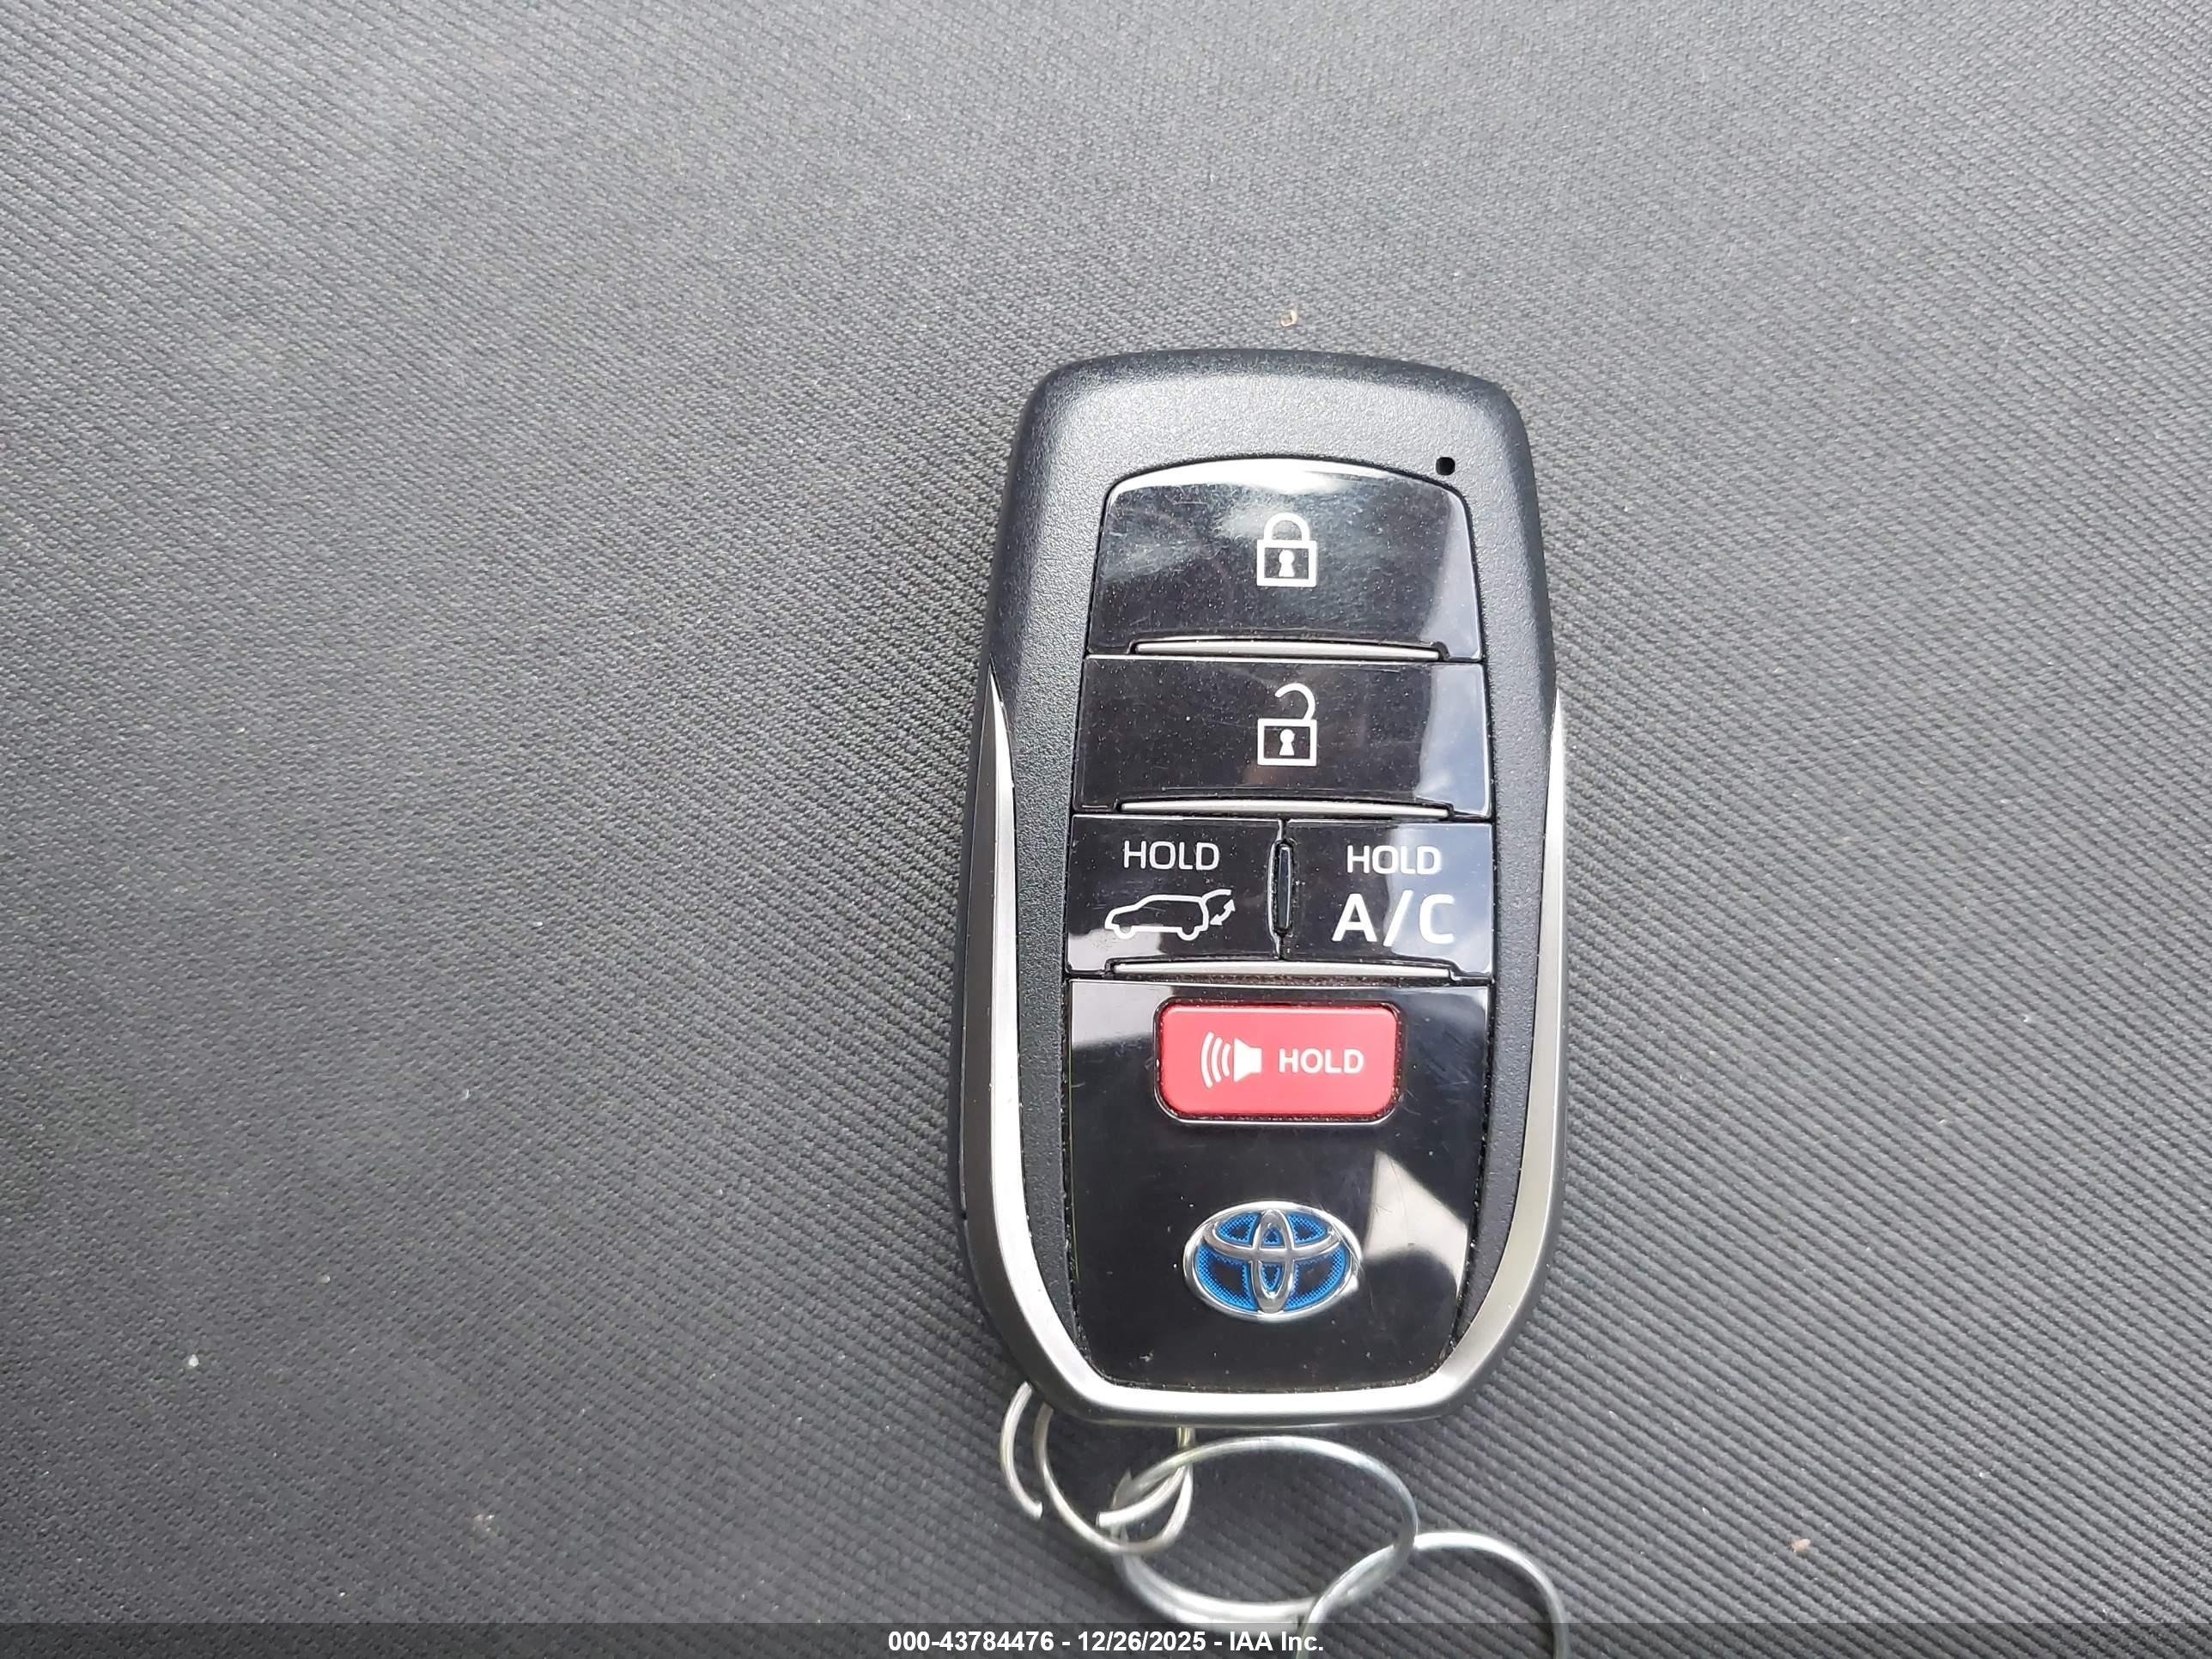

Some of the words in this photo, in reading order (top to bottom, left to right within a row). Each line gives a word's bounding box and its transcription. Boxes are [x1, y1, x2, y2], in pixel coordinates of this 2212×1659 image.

[1123, 840, 1220, 872] HOLD
[1346, 844, 1442, 875] HOLD
[1332, 890, 1455, 947] A/C
[1278, 1048, 1364, 1074] HOLD
